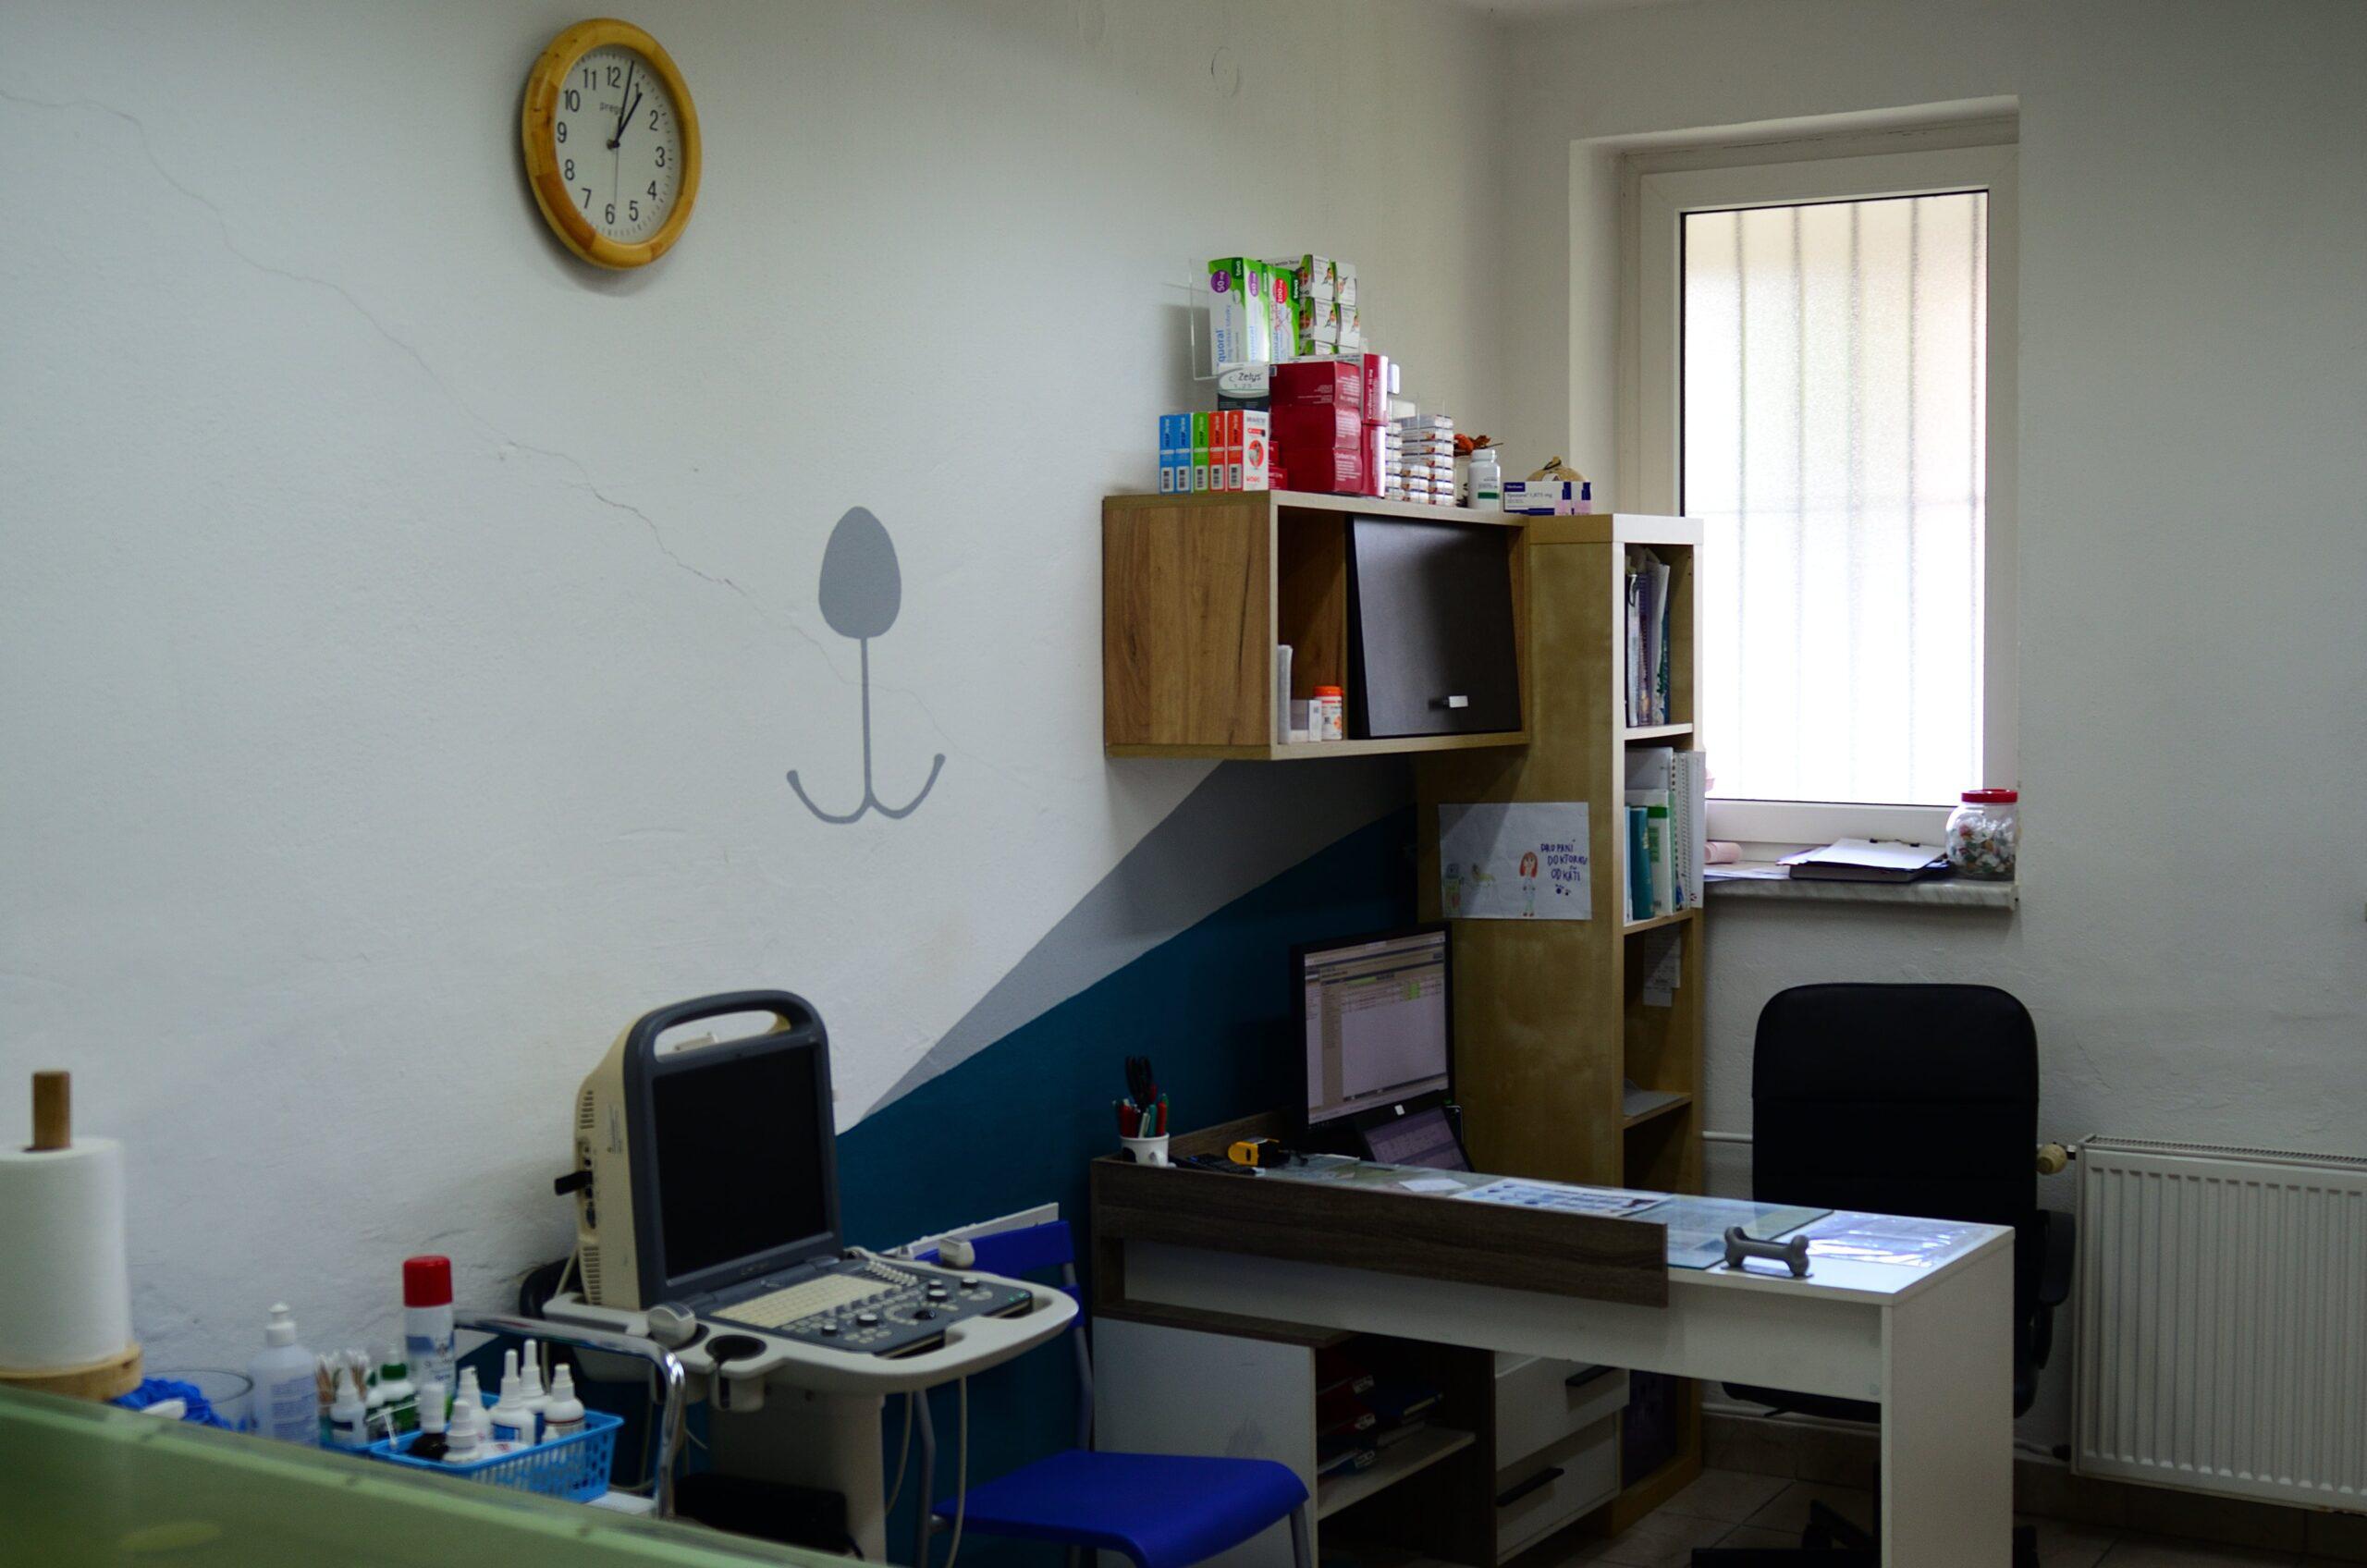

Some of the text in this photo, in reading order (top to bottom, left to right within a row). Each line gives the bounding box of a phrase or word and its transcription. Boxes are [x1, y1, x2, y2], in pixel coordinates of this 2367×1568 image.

[583, 68, 597, 91] 11
[607, 66, 621, 89] 12
[564, 90, 581, 112] 10
[649, 109, 658, 131] 2
[557, 122, 567, 143] 9
[656, 146, 665, 167] 3
[564, 159, 575, 181] 8
[582, 188, 592, 209] 7
[647, 180, 657, 201] 4
[606, 203, 615, 225] 6
[629, 201, 639, 221] 5
[1217, 280, 1225, 292] 50
[1239, 373, 1261, 383] Zelys
